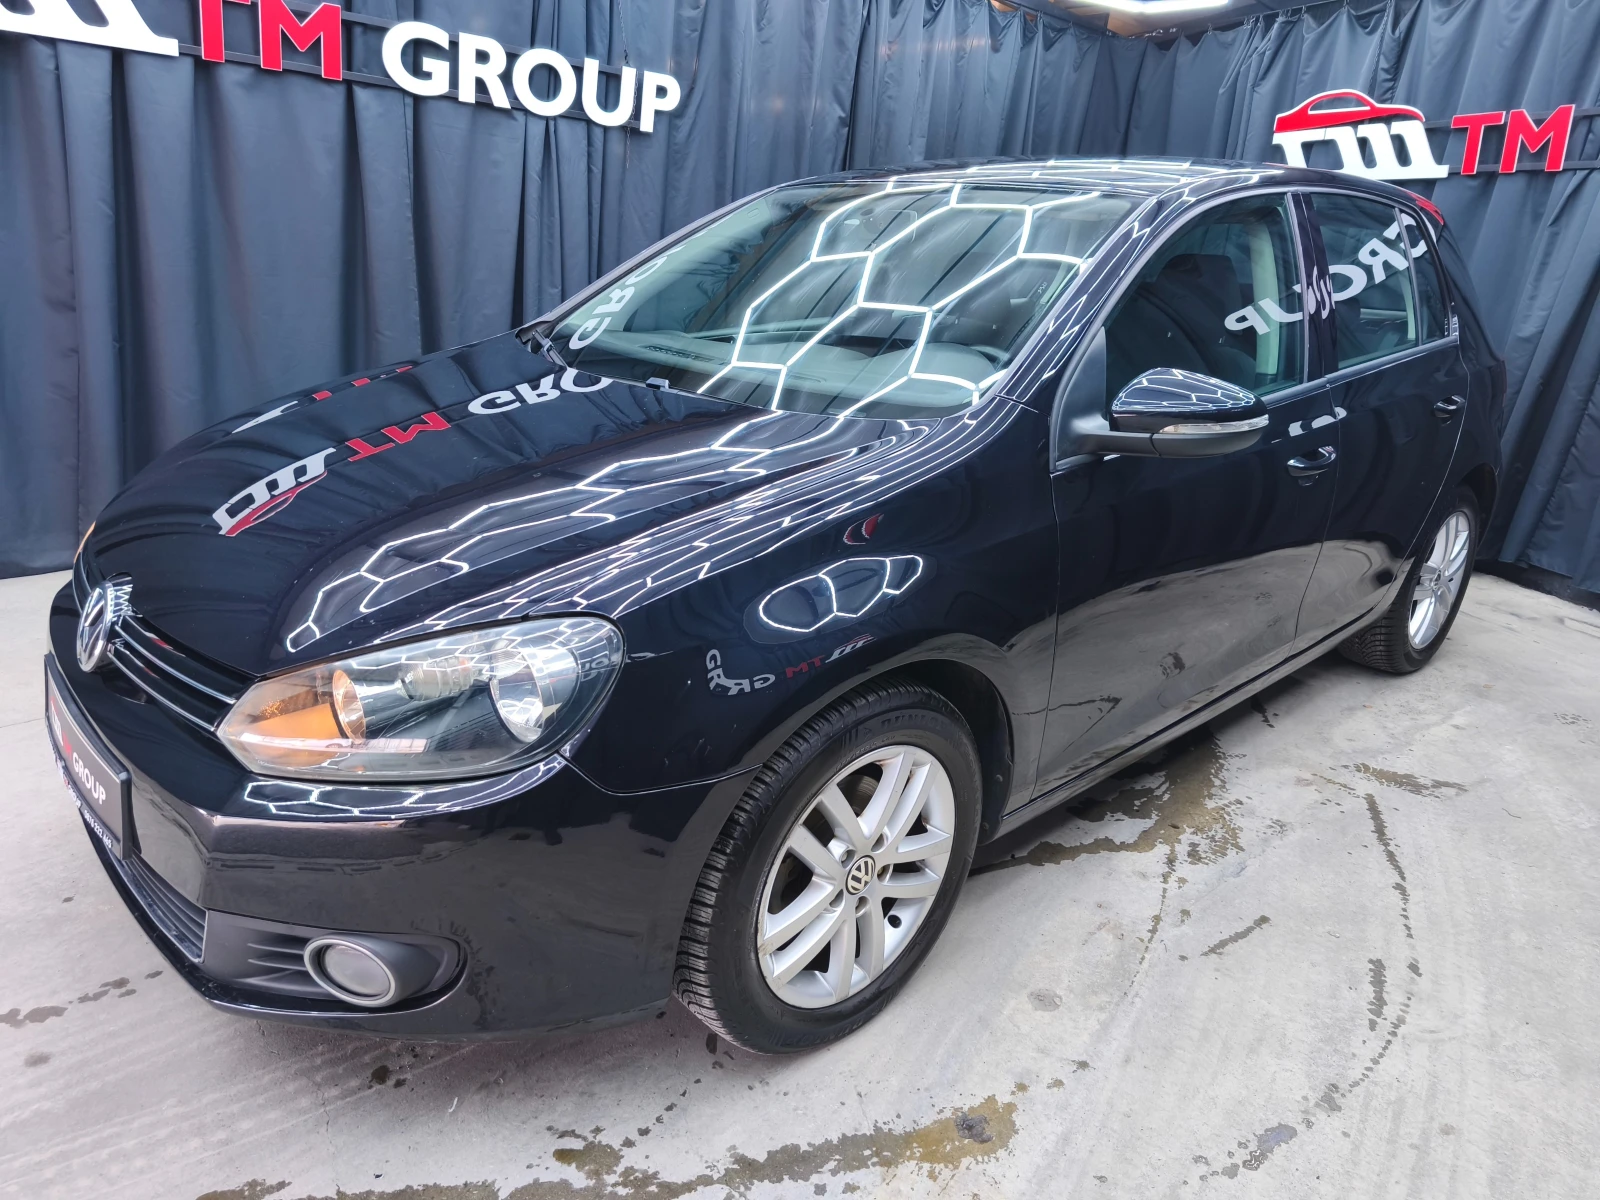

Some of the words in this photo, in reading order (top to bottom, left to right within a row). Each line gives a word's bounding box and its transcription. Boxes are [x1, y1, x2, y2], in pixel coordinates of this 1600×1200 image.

[199, 0, 343, 81] TM
[381, 21, 682, 133] GROUP
[1451, 104, 1576, 176] TM
[73, 752, 106, 805] GROUP
